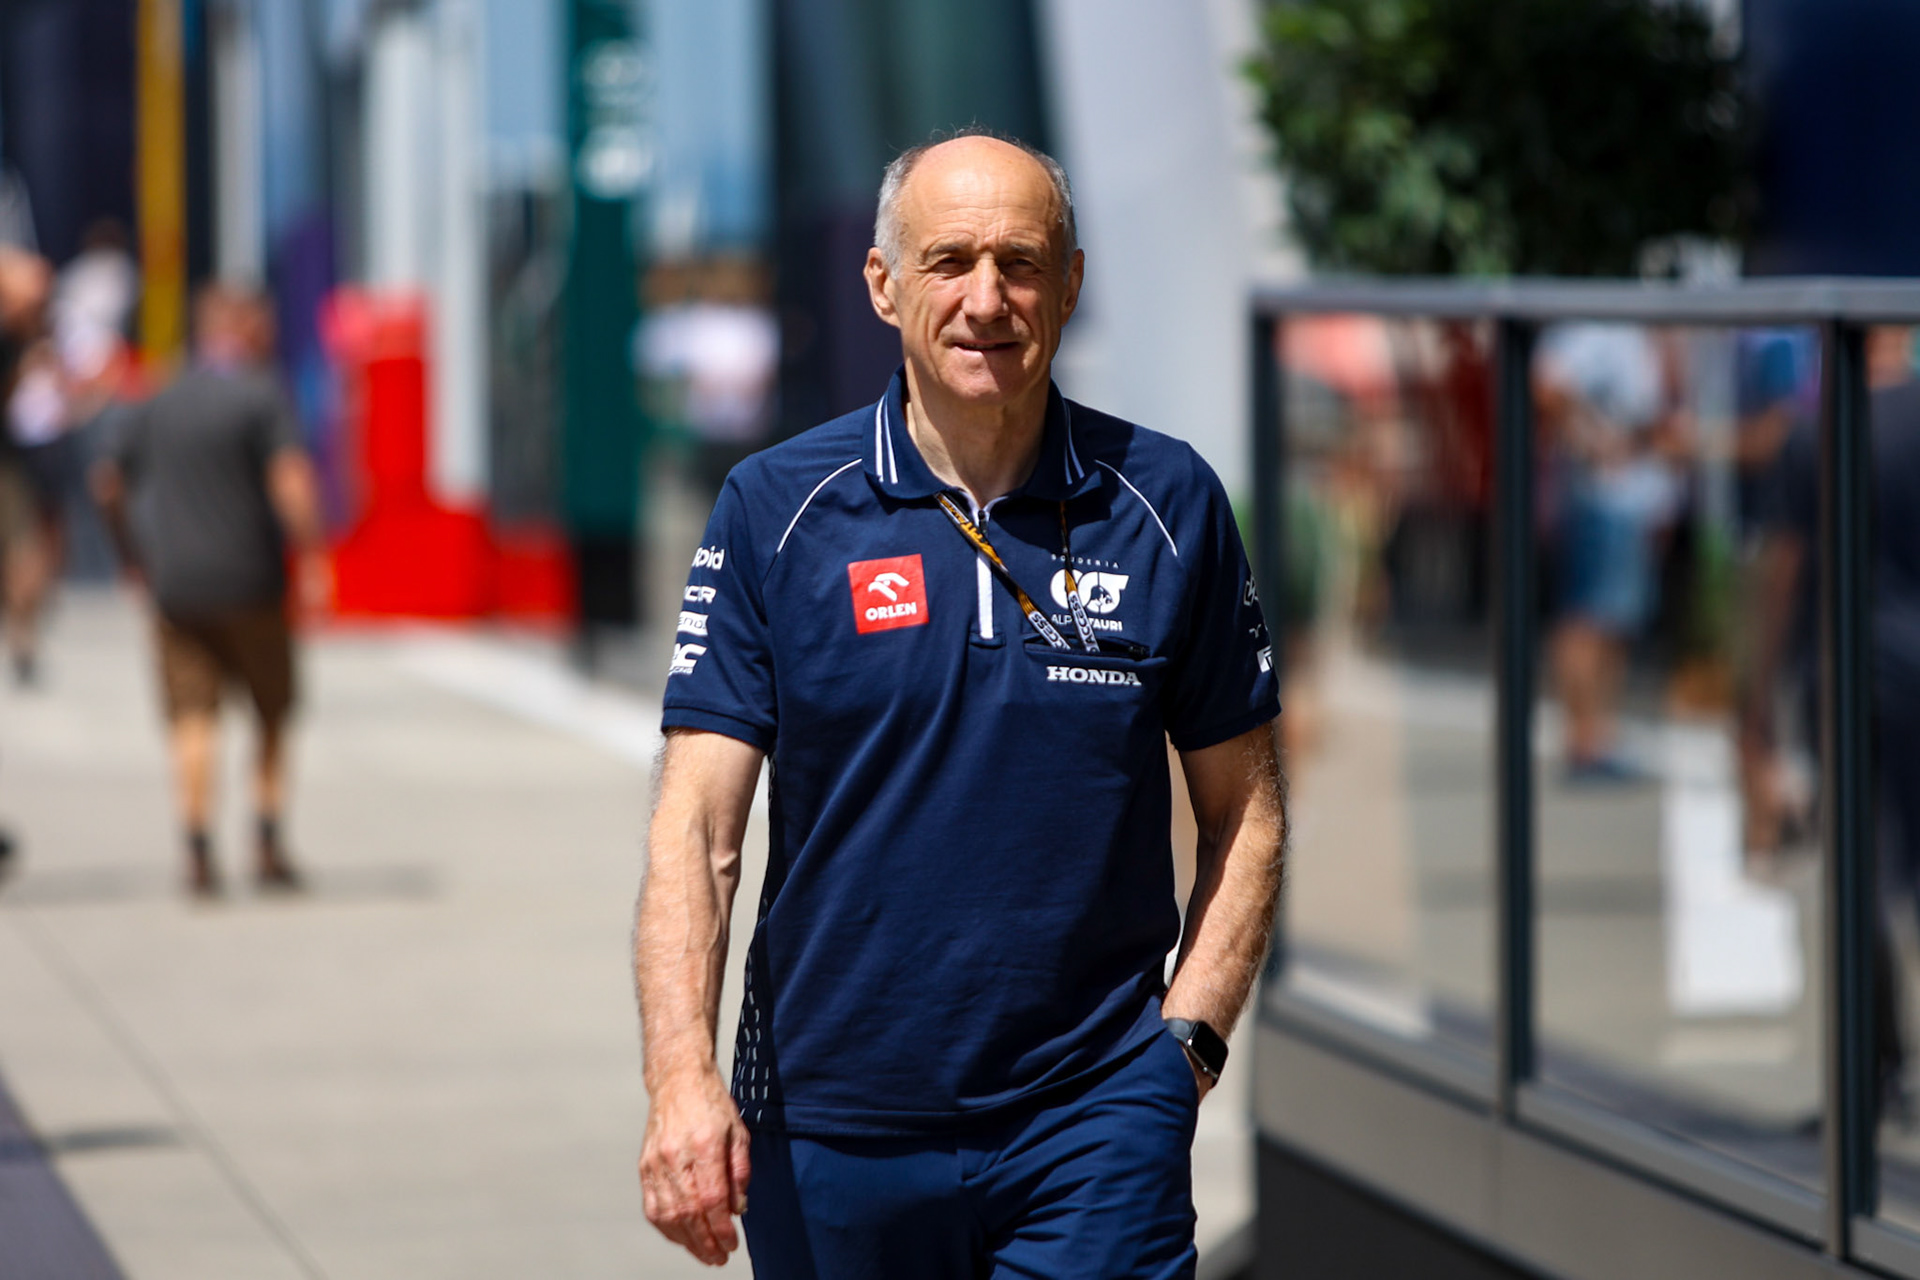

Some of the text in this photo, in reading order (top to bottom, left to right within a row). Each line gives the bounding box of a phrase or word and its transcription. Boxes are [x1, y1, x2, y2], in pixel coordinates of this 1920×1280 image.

[865, 602, 917, 621] ORLEN
[1069, 594, 1095, 645] ACCESS
[1031, 613, 1069, 649] CCESS
[1051, 613, 1123, 632] ALPTAURI
[1046, 666, 1142, 687] HONDA
